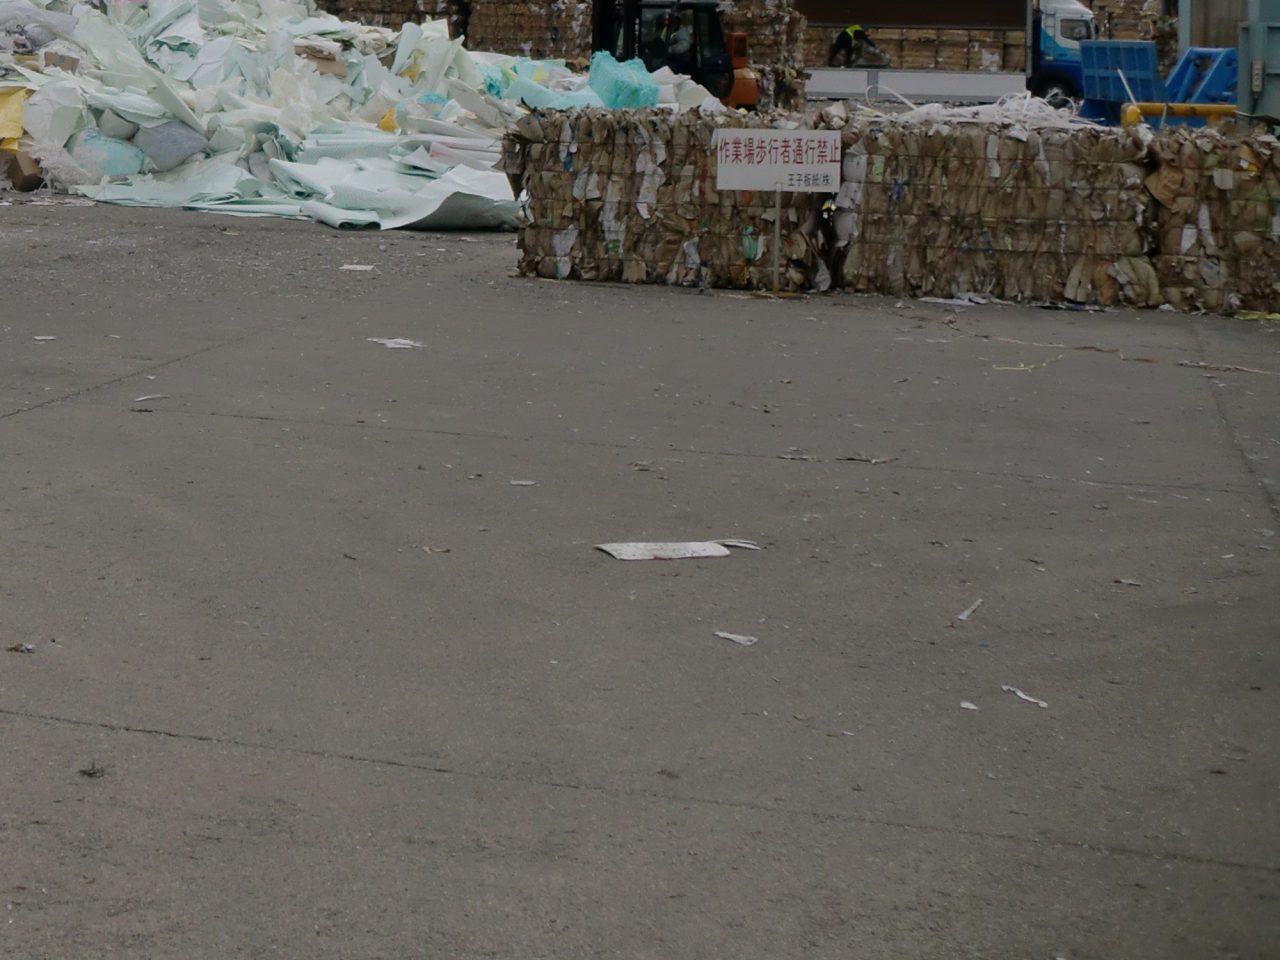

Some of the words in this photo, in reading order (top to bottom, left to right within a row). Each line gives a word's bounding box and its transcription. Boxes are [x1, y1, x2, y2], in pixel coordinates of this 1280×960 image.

[719, 137, 841, 165] 作業場歩行者通行禁止
